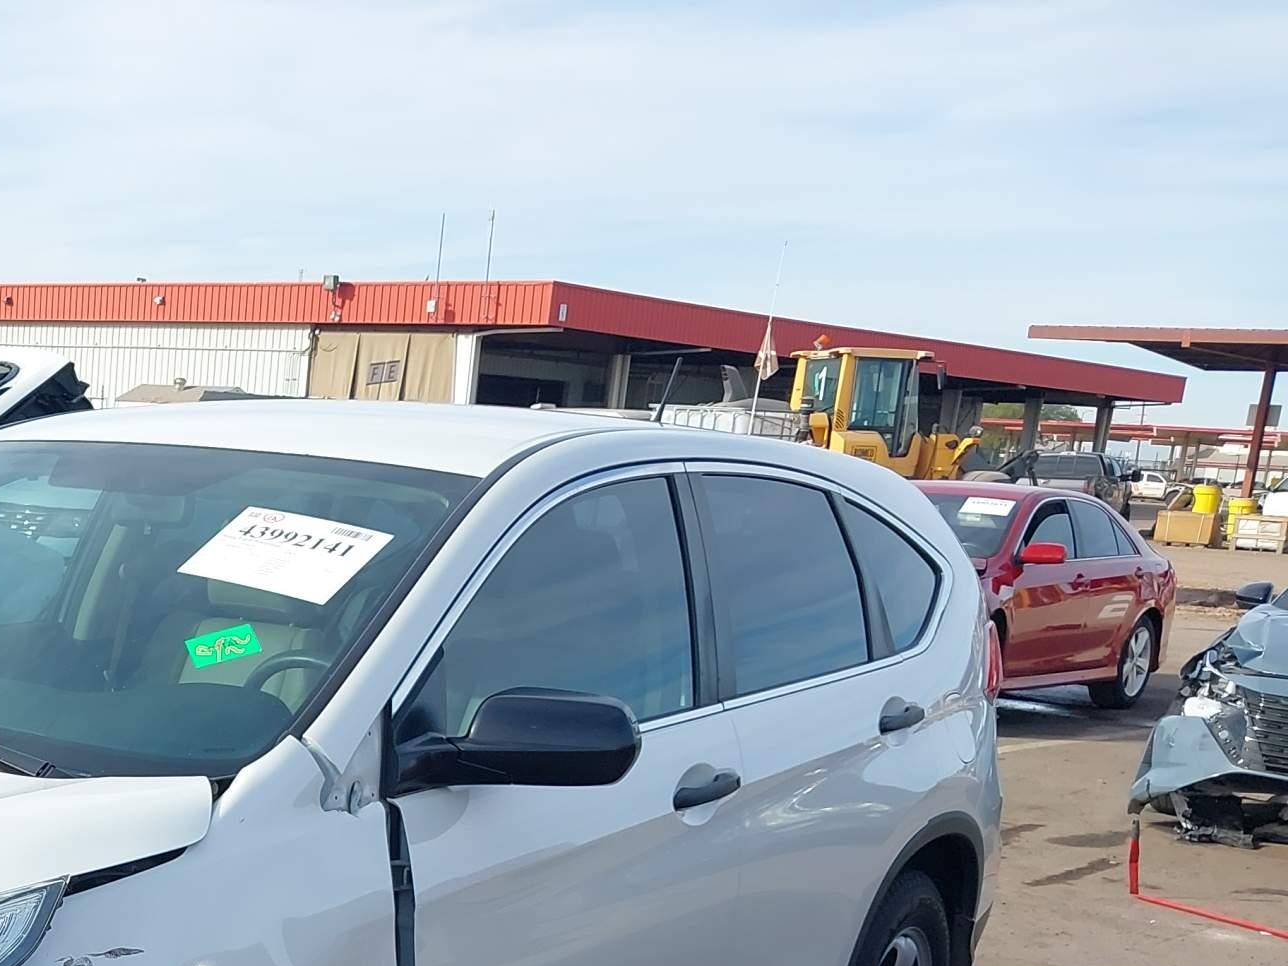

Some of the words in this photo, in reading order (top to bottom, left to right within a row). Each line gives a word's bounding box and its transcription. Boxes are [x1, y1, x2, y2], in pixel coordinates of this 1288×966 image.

[371, 366, 379, 381] F
[388, 364, 397, 379] E
[239, 524, 355, 557] 43992141
